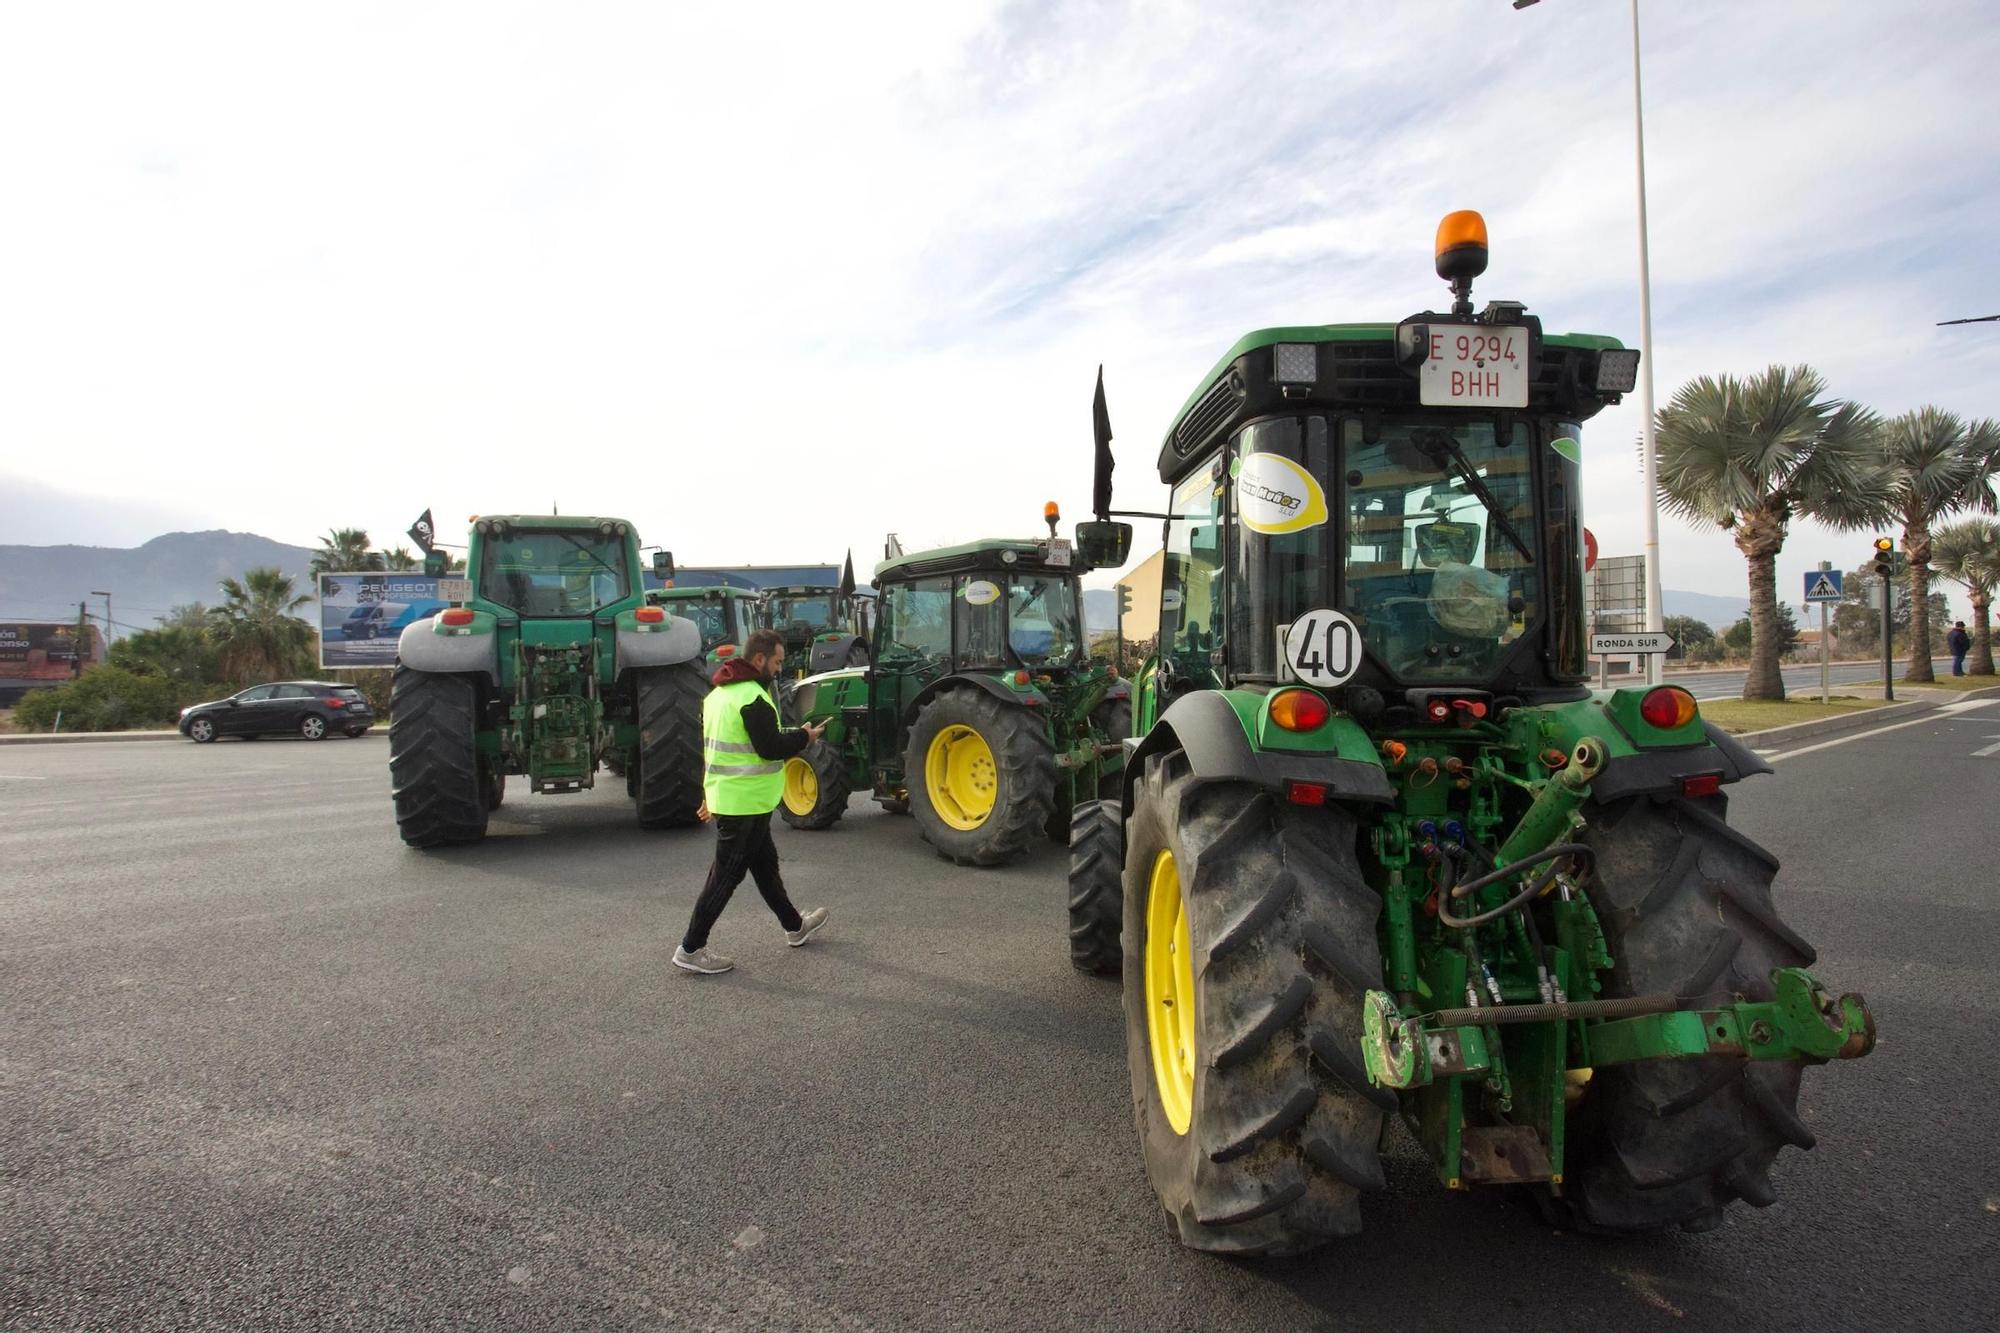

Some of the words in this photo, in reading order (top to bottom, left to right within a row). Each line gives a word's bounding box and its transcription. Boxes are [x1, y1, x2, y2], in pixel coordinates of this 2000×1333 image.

[1430, 334, 1444, 360] E
[1456, 335, 1516, 362] 9294
[1452, 371, 1499, 397] BHH
[359, 583, 437, 593] PEUGEOT
[1296, 619, 1352, 678] 40
[1597, 639, 1634, 648] RONDA
[1637, 638, 1659, 647] SUR
